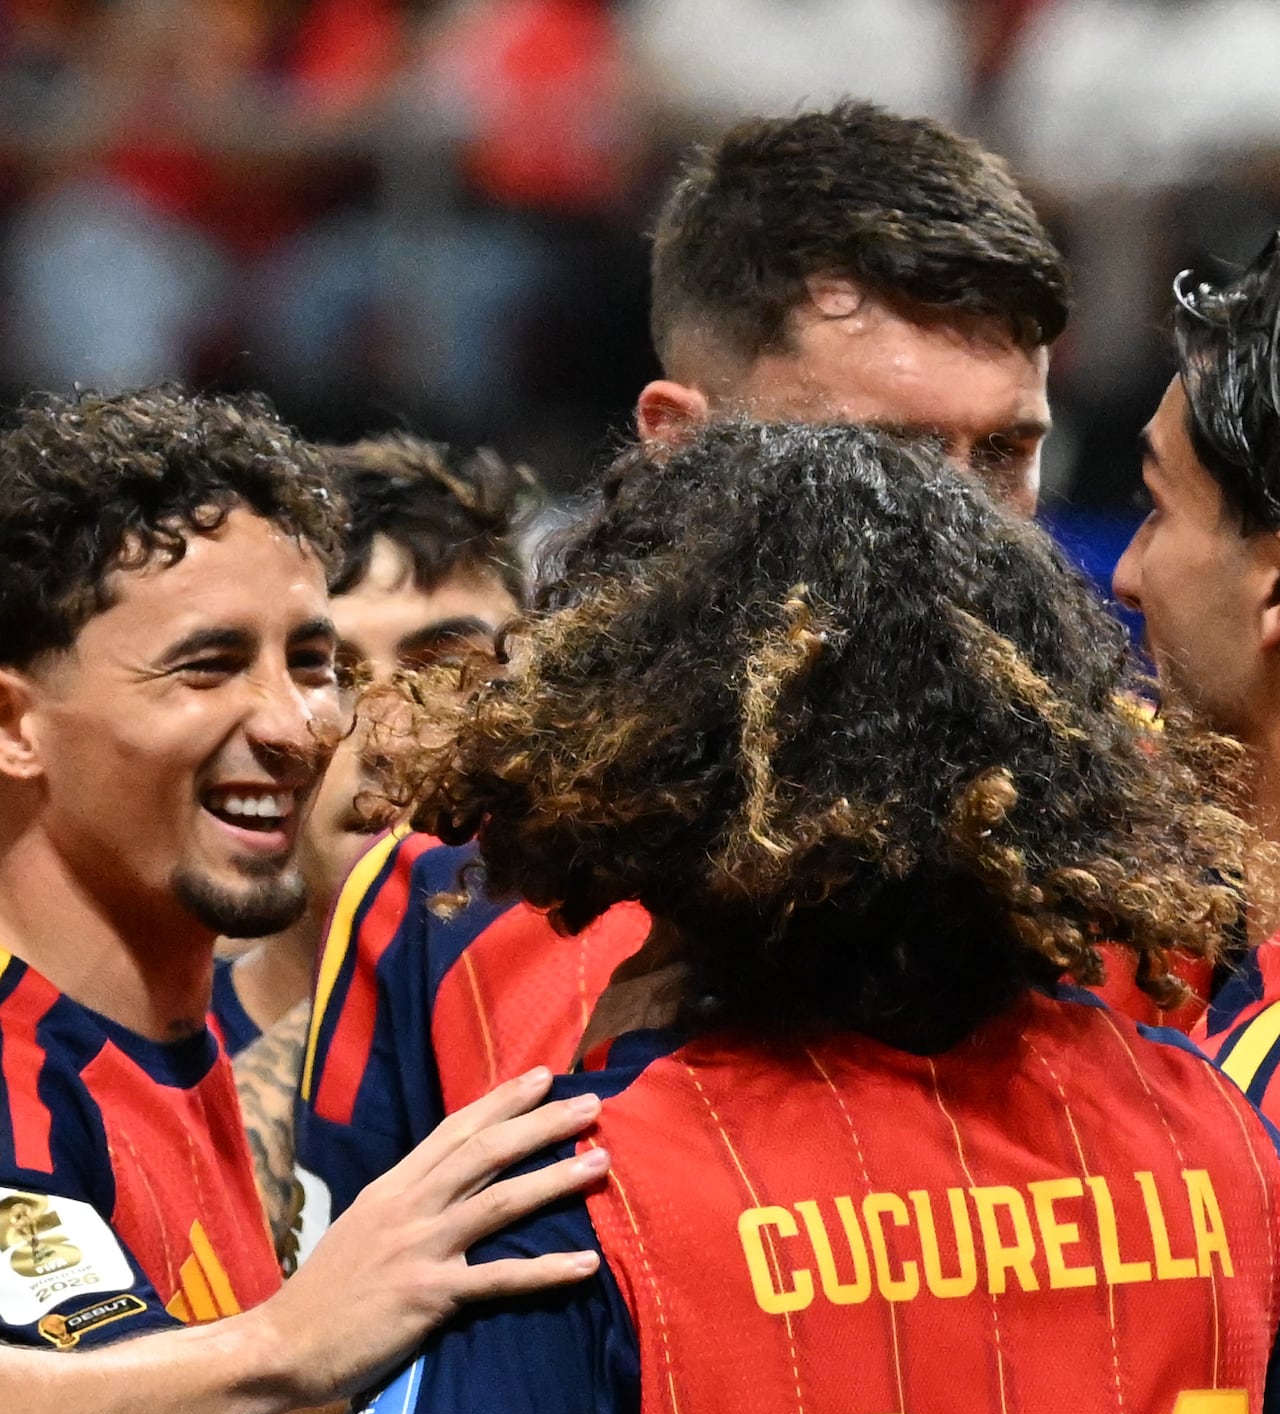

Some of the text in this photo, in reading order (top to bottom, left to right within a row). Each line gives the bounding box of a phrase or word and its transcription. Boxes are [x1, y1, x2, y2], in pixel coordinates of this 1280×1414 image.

[737, 1168, 1235, 1315] CUCURELLA
[35, 1272, 100, 1303] 2026
[68, 1298, 128, 1328] DEBUT
